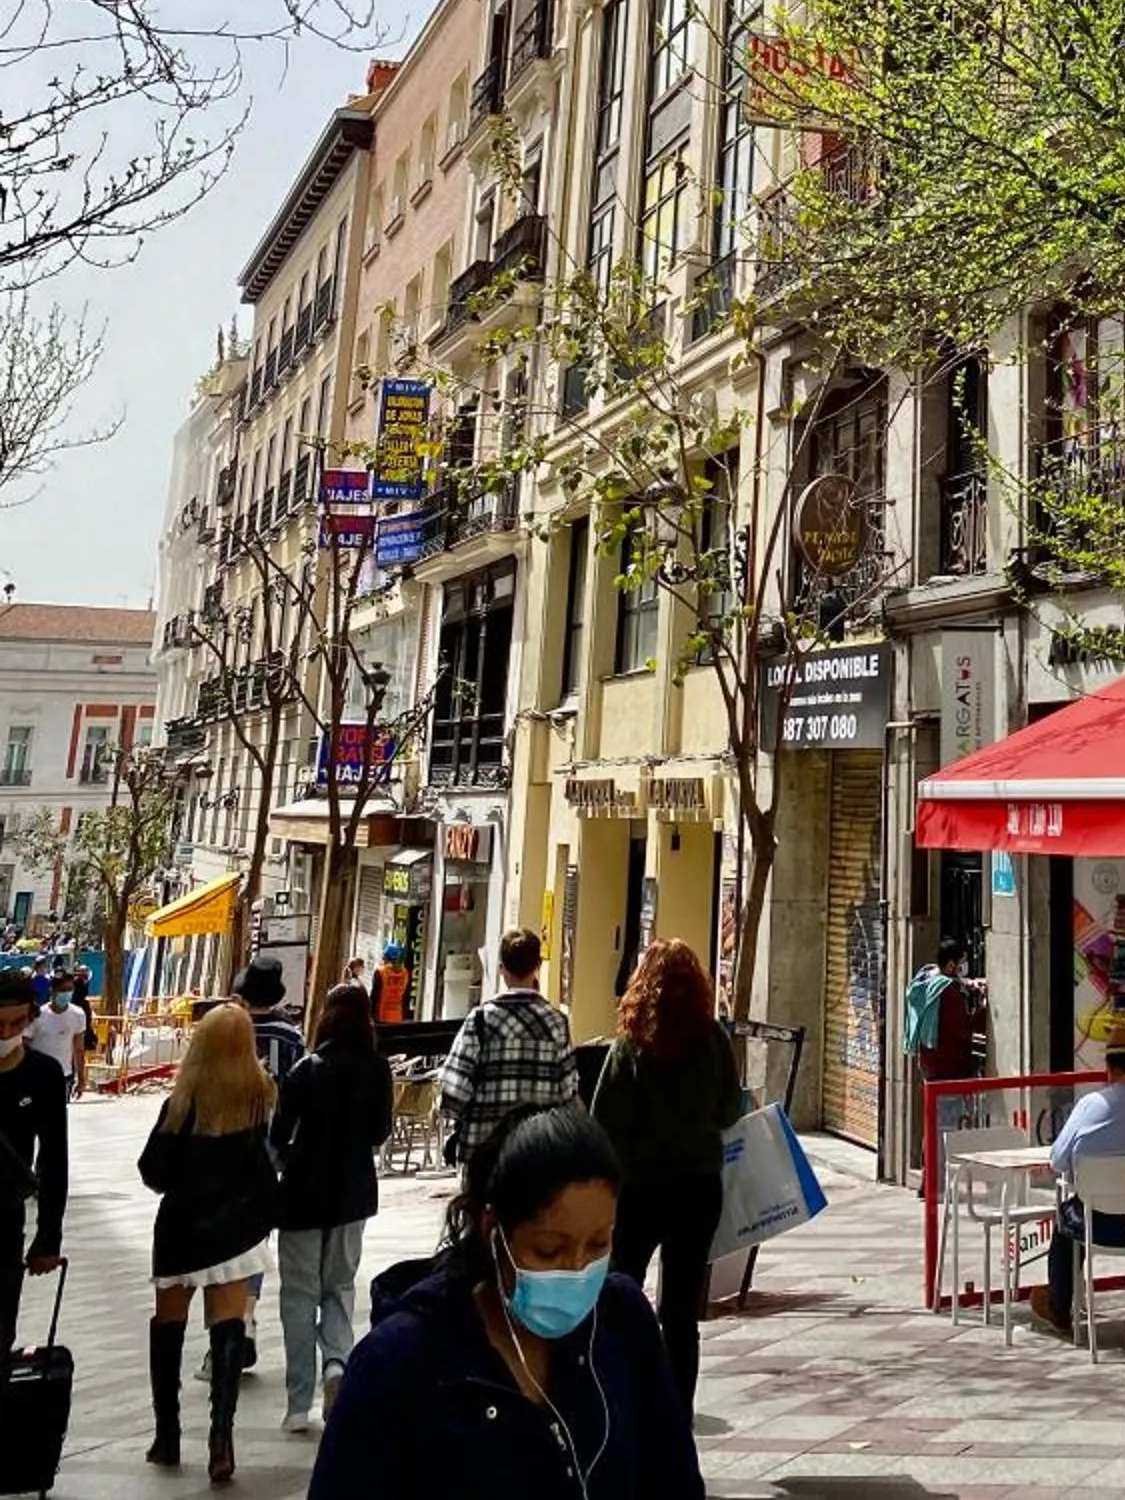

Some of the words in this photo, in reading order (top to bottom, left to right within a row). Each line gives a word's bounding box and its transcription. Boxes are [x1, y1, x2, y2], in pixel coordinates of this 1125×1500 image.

[805, 654, 880, 683] DISPONIBLE
[806, 715, 828, 741] 307
[831, 714, 857, 739] 080
